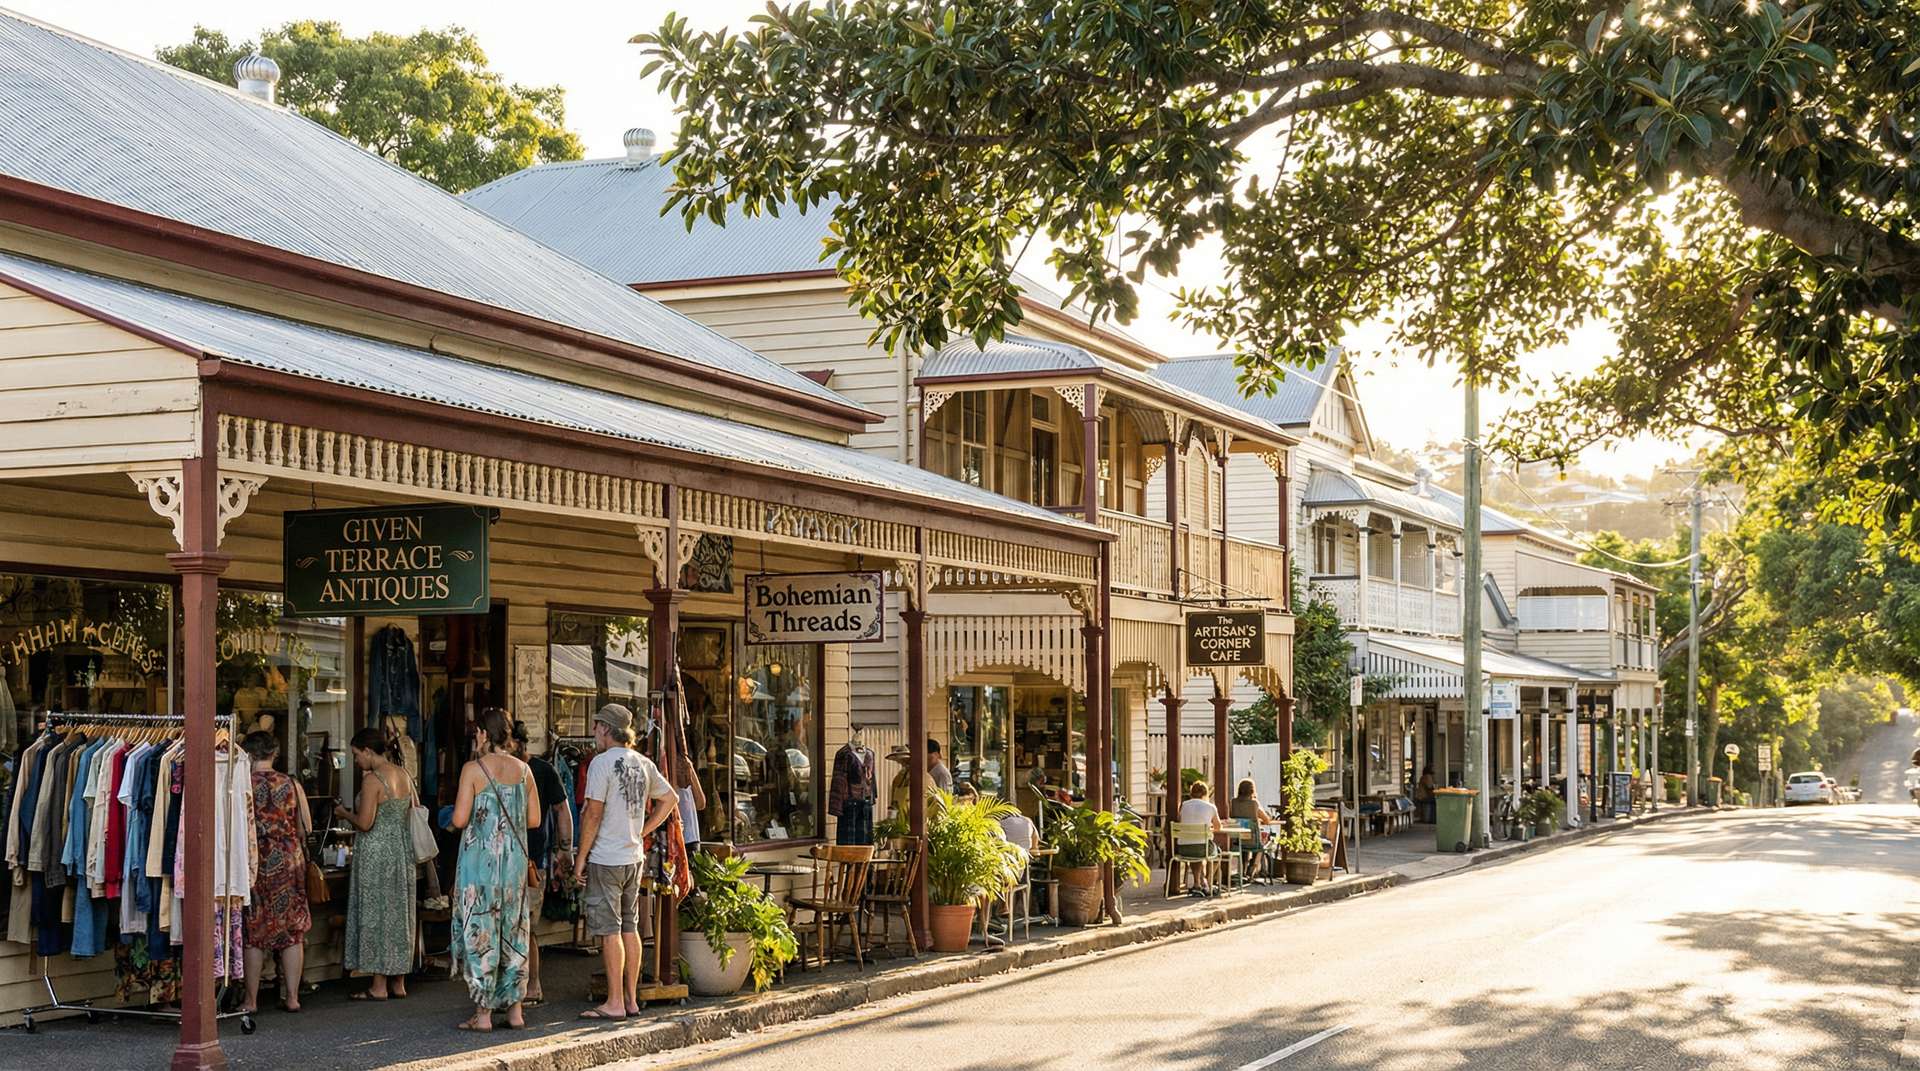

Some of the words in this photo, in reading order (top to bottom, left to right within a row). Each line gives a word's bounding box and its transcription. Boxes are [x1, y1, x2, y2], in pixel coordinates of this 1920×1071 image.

[343, 516, 423, 543] GIVEN
[325, 545, 443, 573] TERRACE
[320, 574, 450, 606] ANTIQUES
[756, 583, 872, 607] Bohemian
[765, 609, 862, 633] Threads
[1194, 625, 1257, 638] ARTISAN'S
[1217, 616, 1233, 625] The
[1200, 638, 1251, 649] CORNER
[1210, 650, 1241, 661] CAFE
